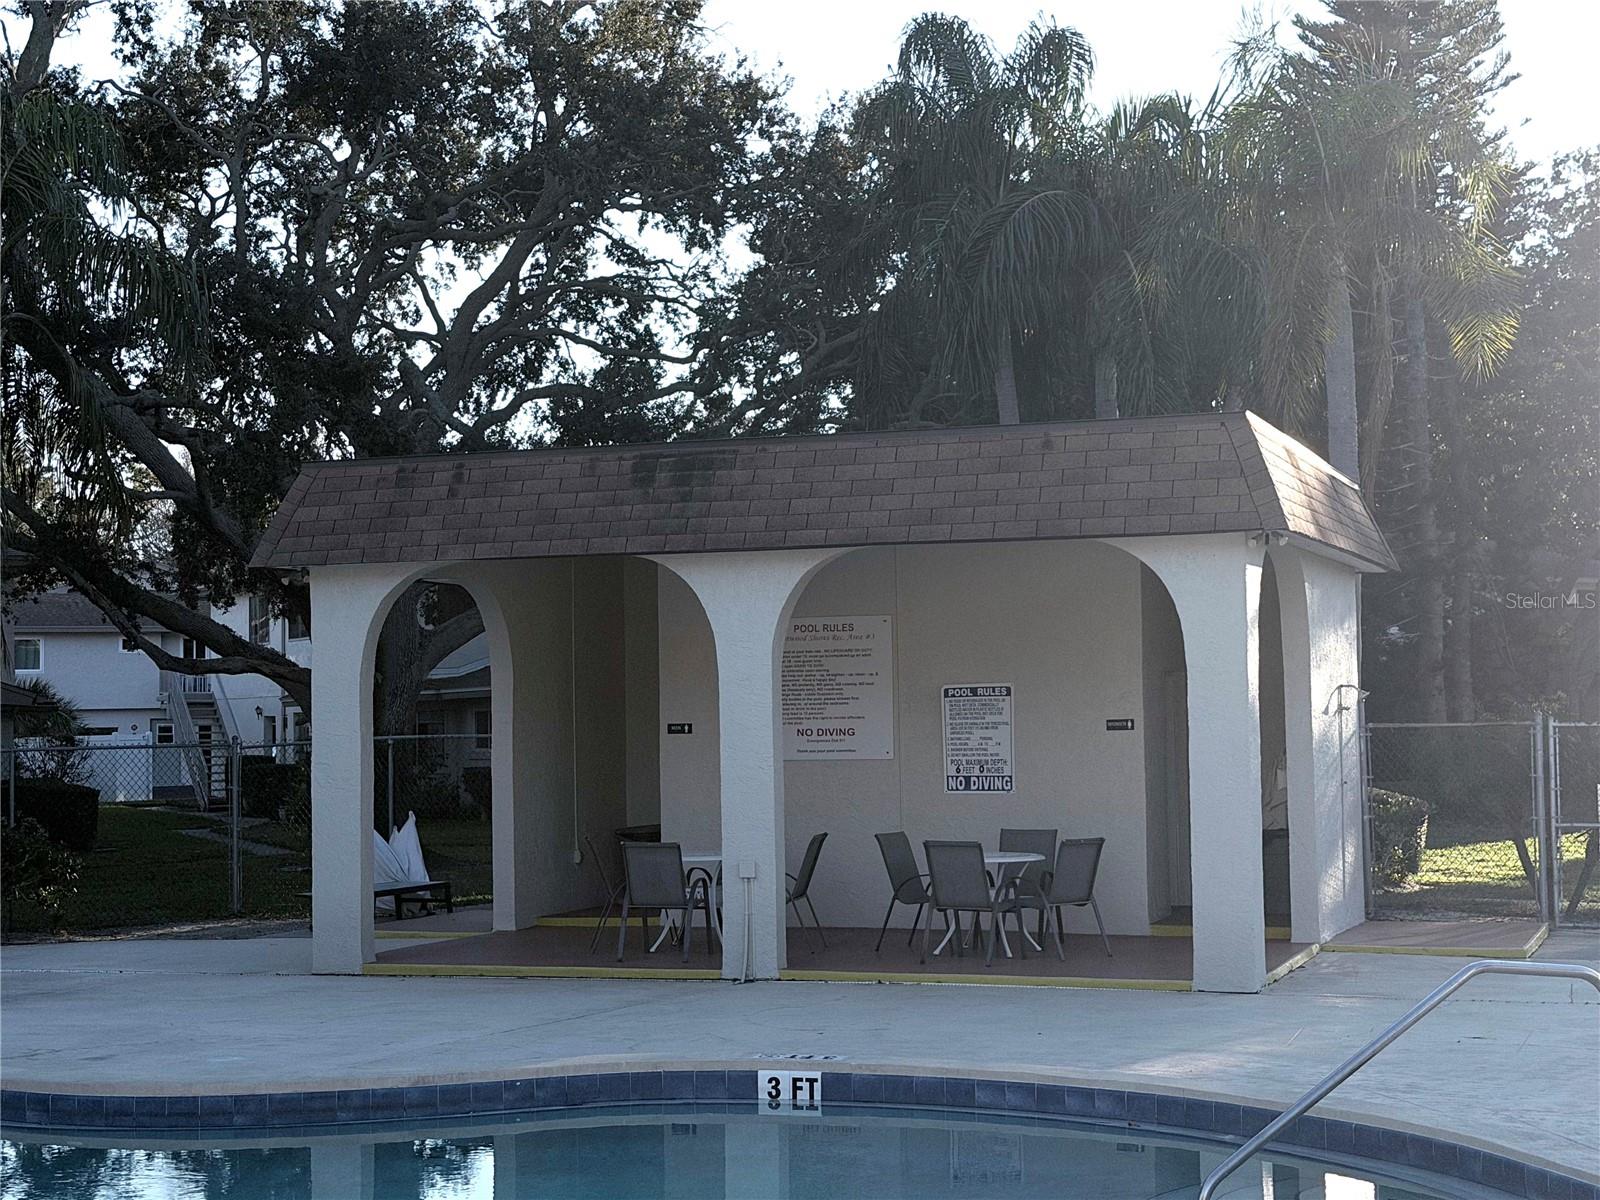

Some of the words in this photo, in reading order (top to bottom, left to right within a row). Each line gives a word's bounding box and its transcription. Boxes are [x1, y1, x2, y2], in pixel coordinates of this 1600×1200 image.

[793, 624, 820, 633] POOL
[822, 623, 855, 632] RULES
[948, 688, 973, 697] POOL
[977, 687, 1007, 696] RULES
[796, 728, 814, 737] NO
[817, 727, 856, 737] DIVING
[962, 766, 975, 774] FEET
[986, 766, 1004, 774] INCHES
[948, 776, 965, 791] NO
[970, 776, 1012, 791] DIVING
[767, 1076, 781, 1100] 3
[792, 1077, 819, 1101] FT
